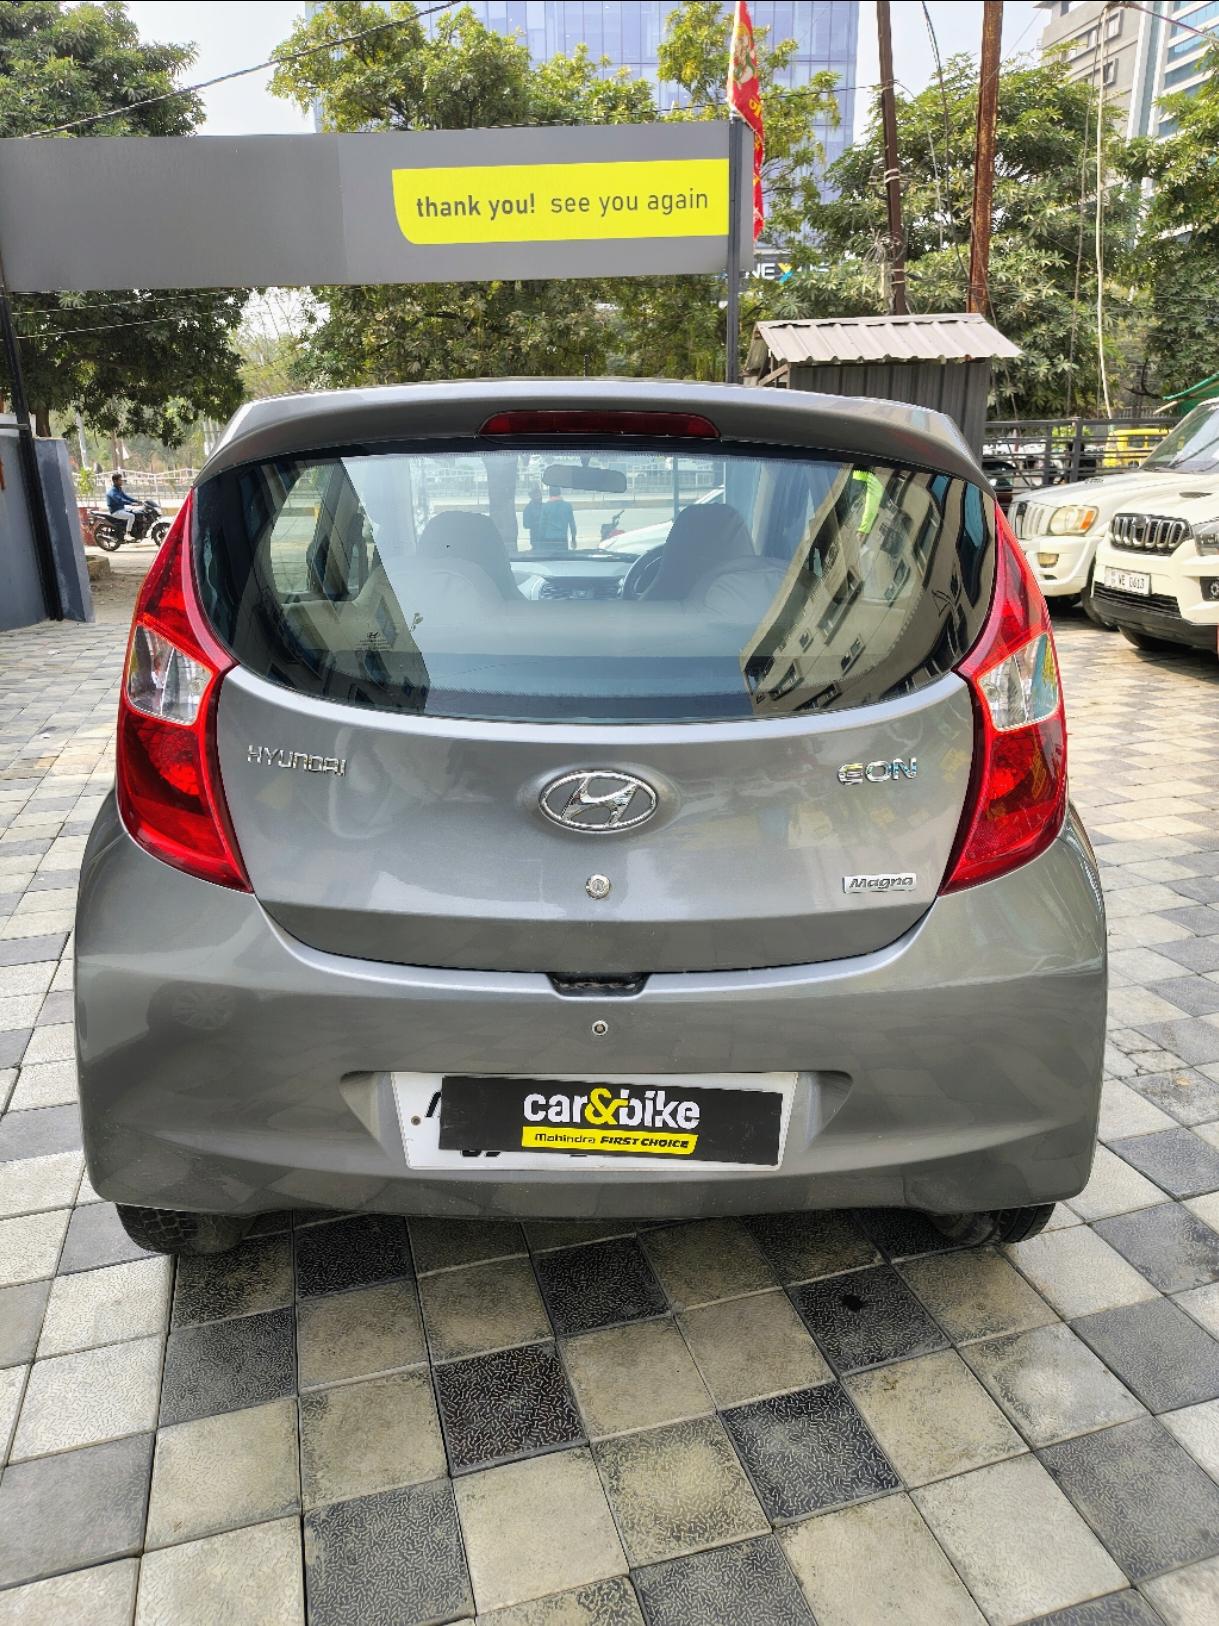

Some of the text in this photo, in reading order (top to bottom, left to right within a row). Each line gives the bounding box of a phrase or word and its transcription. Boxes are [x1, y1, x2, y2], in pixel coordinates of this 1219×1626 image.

[416, 187, 709, 221] thank you! see you again
[247, 744, 346, 776] HYUNDAI
[837, 757, 917, 785] EON
[849, 876, 914, 889] Magna
[523, 1087, 700, 1129] car&bike
[534, 1133, 689, 1149] Mahindra FIRST CHOICE
